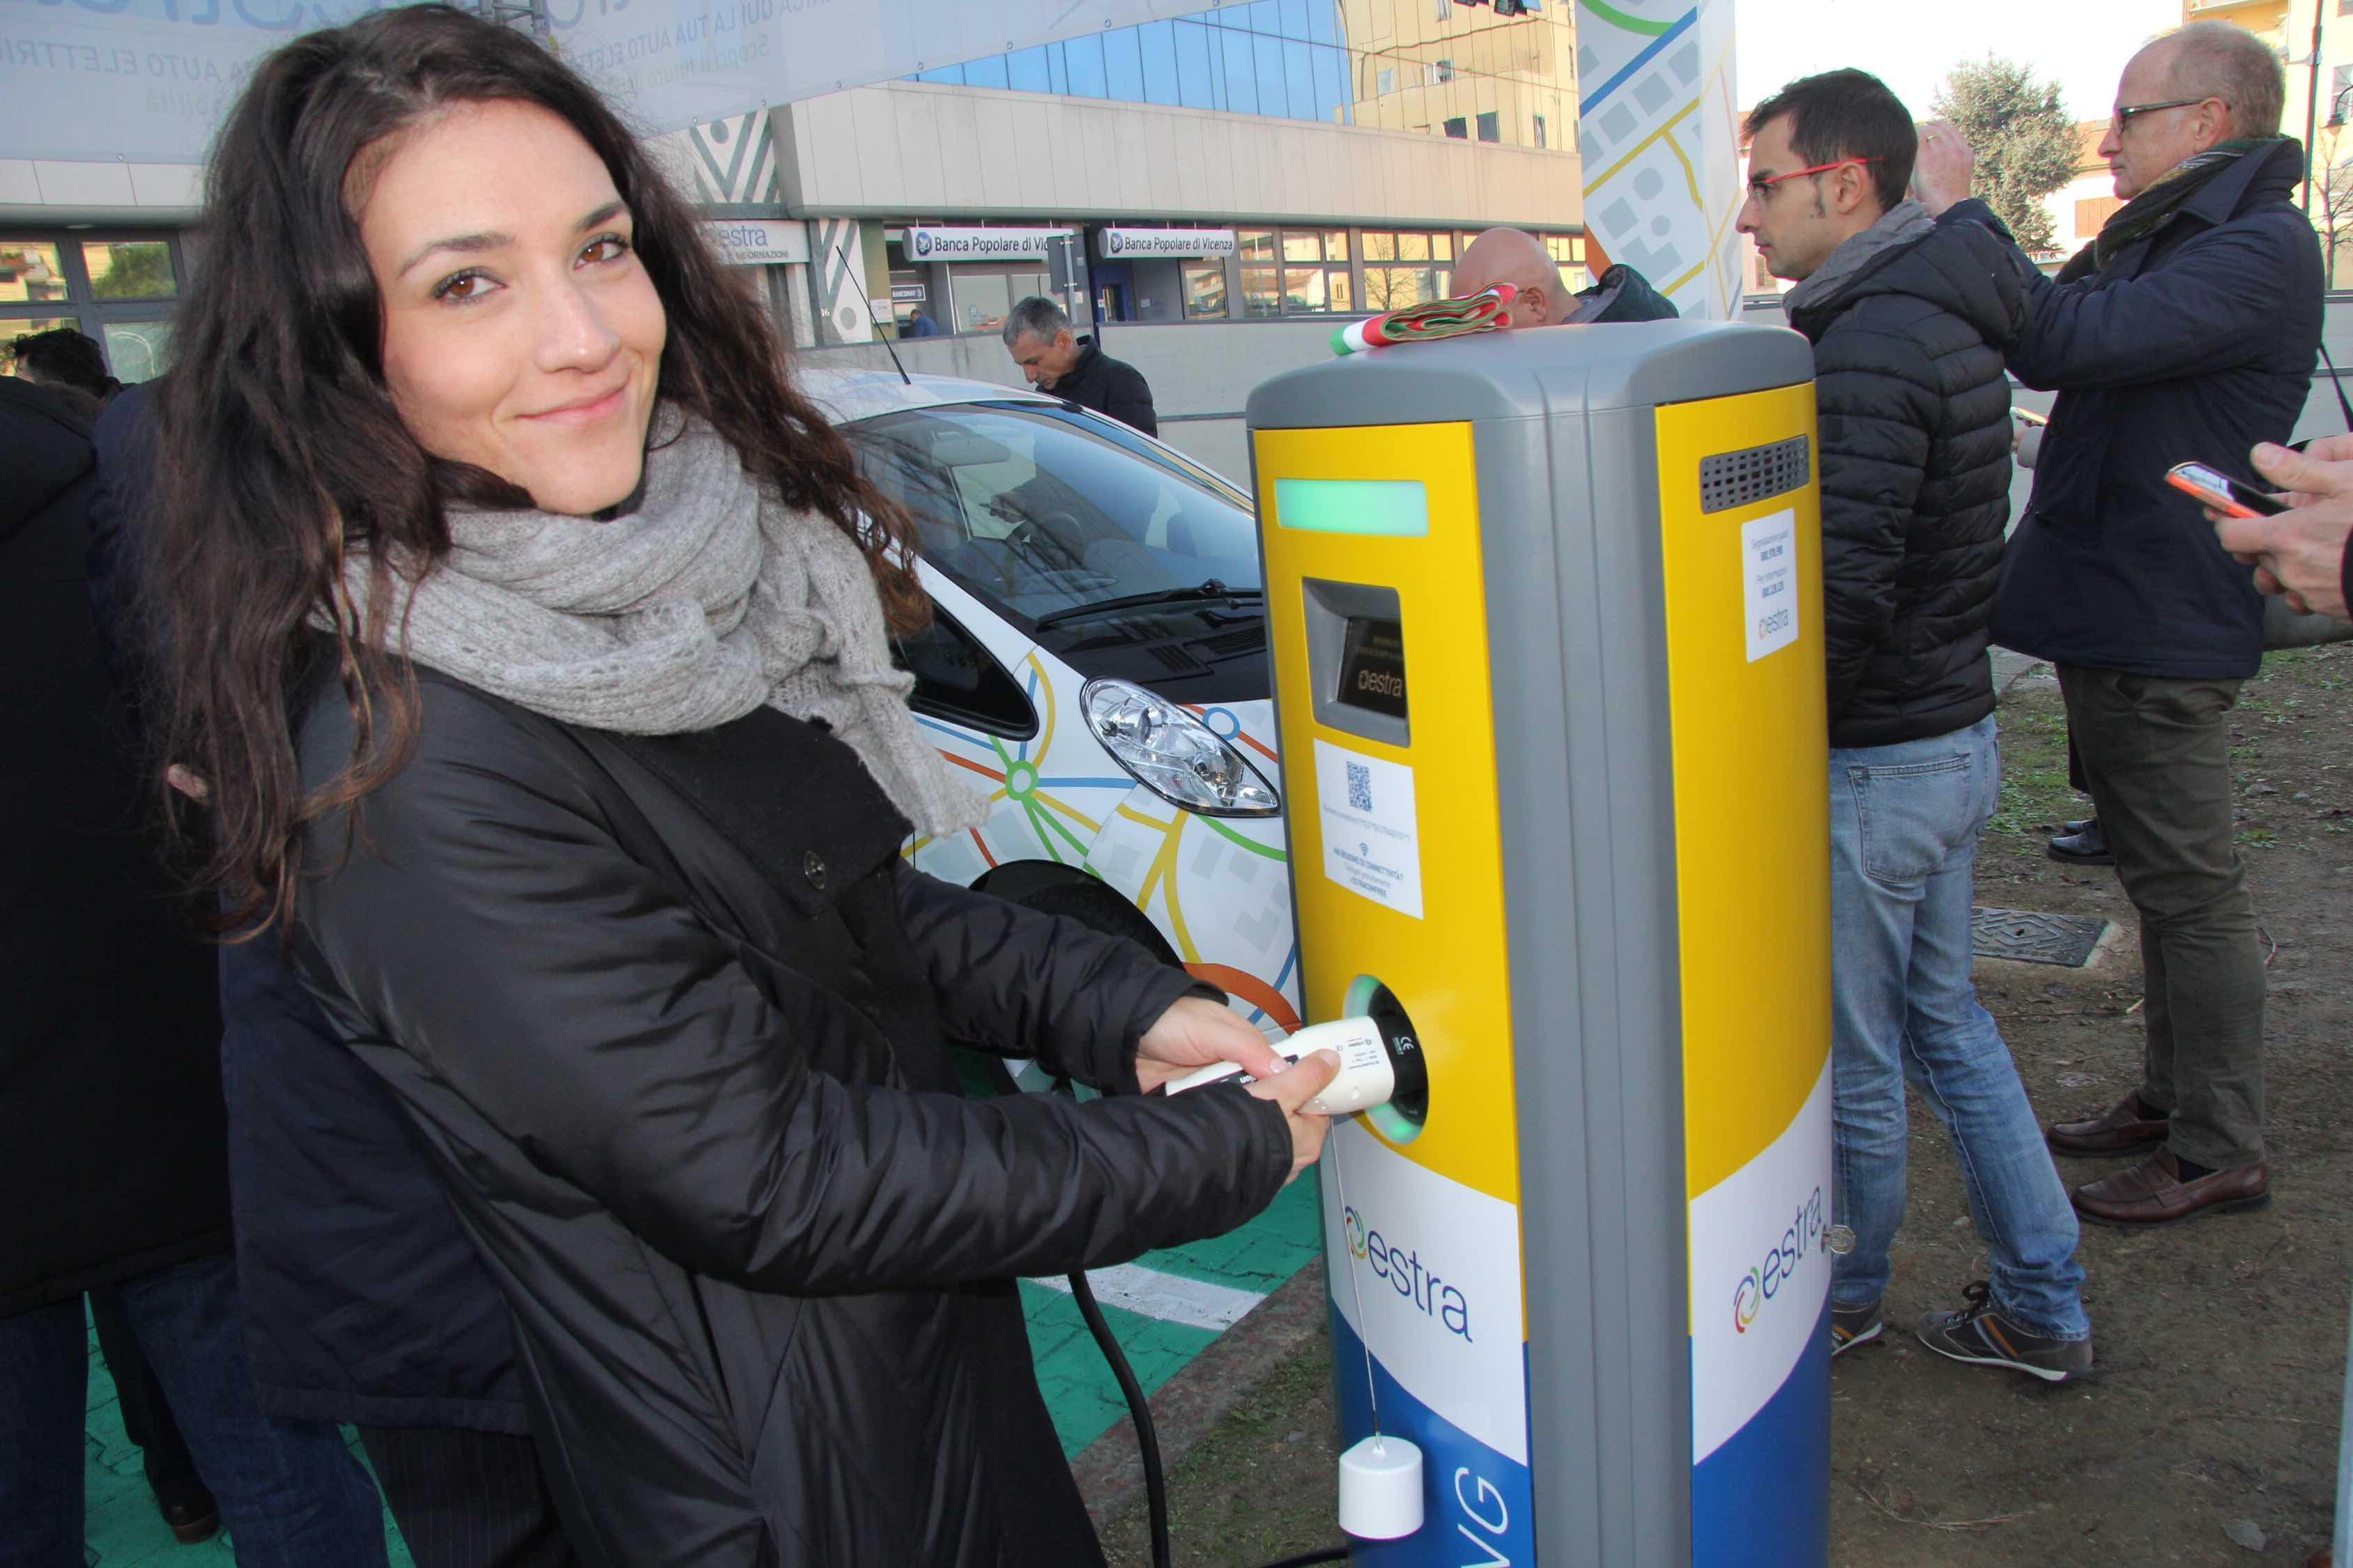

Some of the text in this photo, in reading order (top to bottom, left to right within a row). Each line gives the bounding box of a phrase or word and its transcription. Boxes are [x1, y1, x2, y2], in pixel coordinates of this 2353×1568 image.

[935, 237, 968, 252] Banca
[972, 237, 1018, 254] Popolare
[1022, 236, 1031, 252] di
[1125, 237, 1233, 253] Banca Popolare di Vicenza
